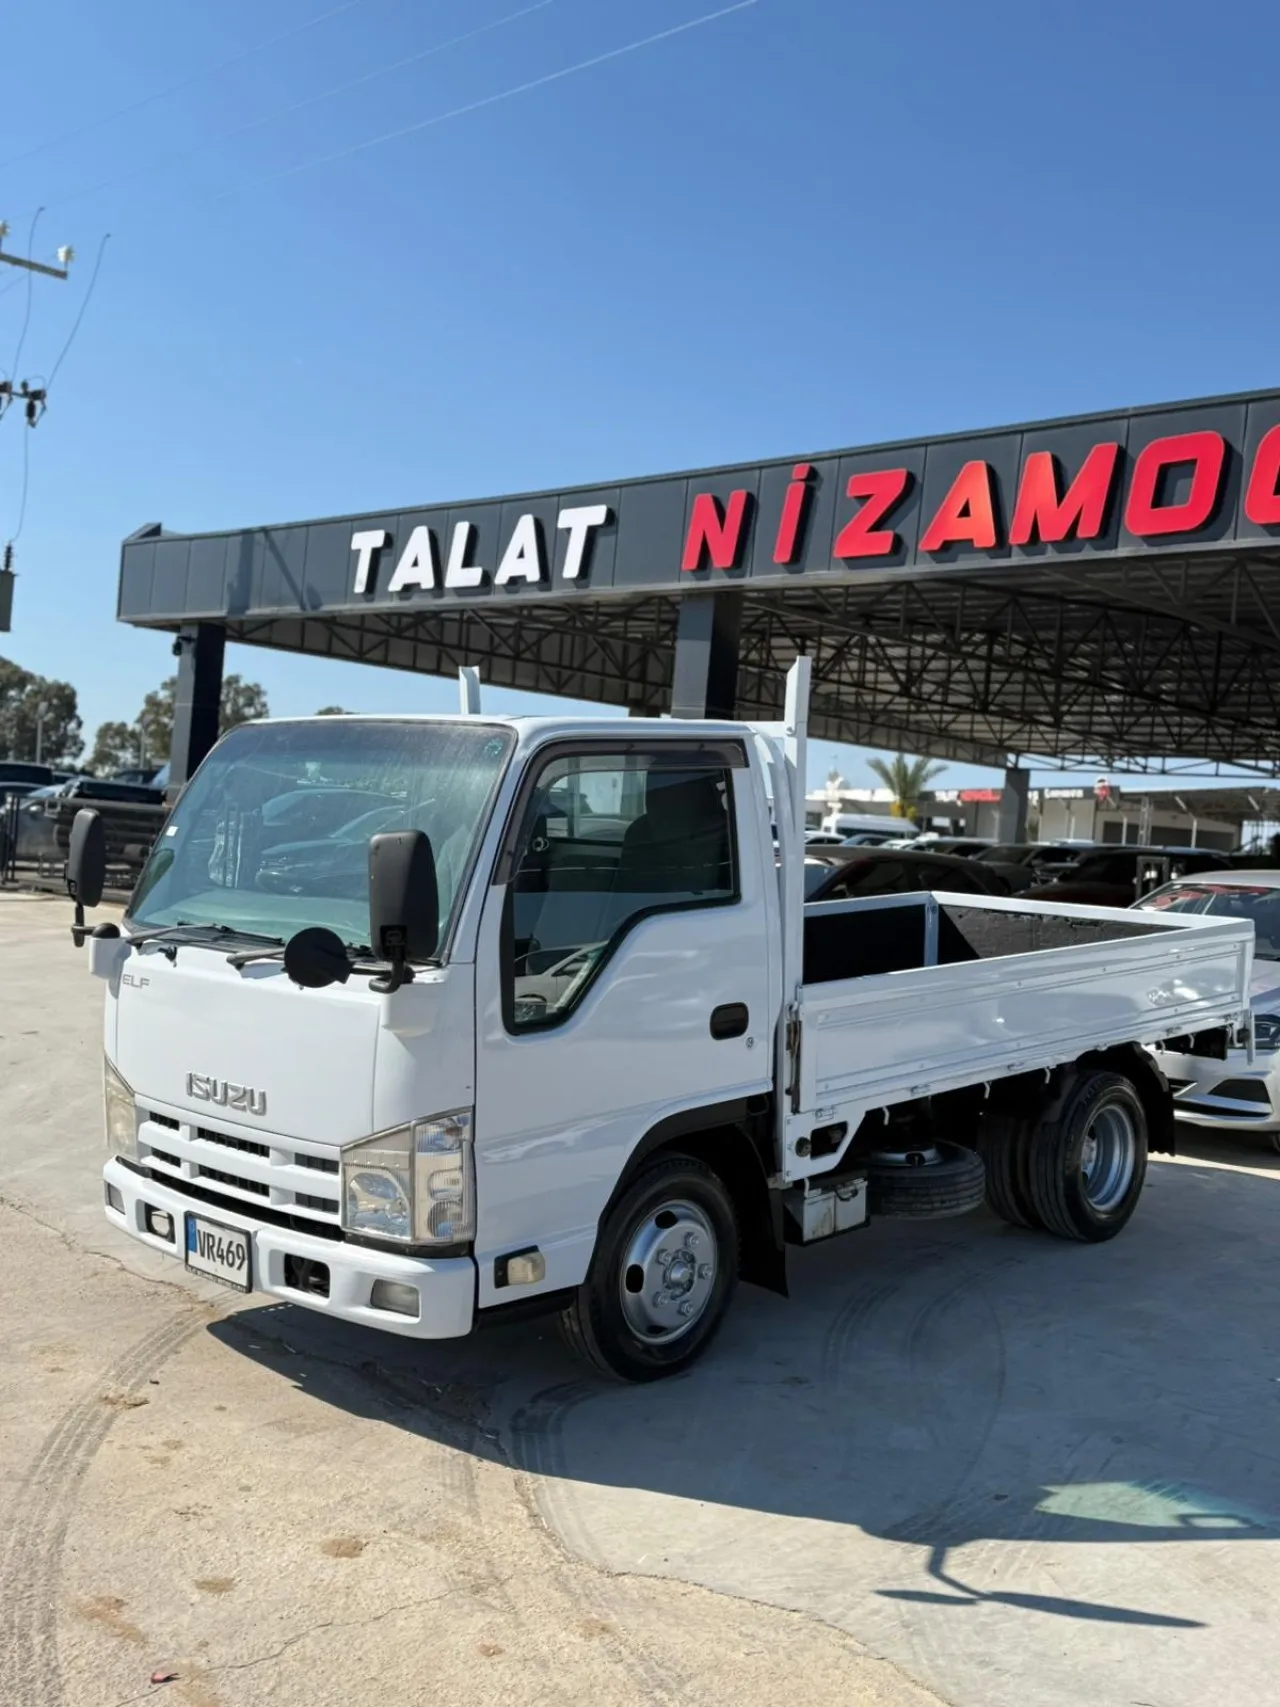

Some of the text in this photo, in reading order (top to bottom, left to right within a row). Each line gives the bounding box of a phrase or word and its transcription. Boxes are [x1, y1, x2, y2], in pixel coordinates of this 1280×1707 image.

[351, 504, 607, 594] TALAT
[123, 973, 150, 989] ELF
[186, 1071, 267, 1117] ISUZU
[197, 1228, 246, 1271] VR469
